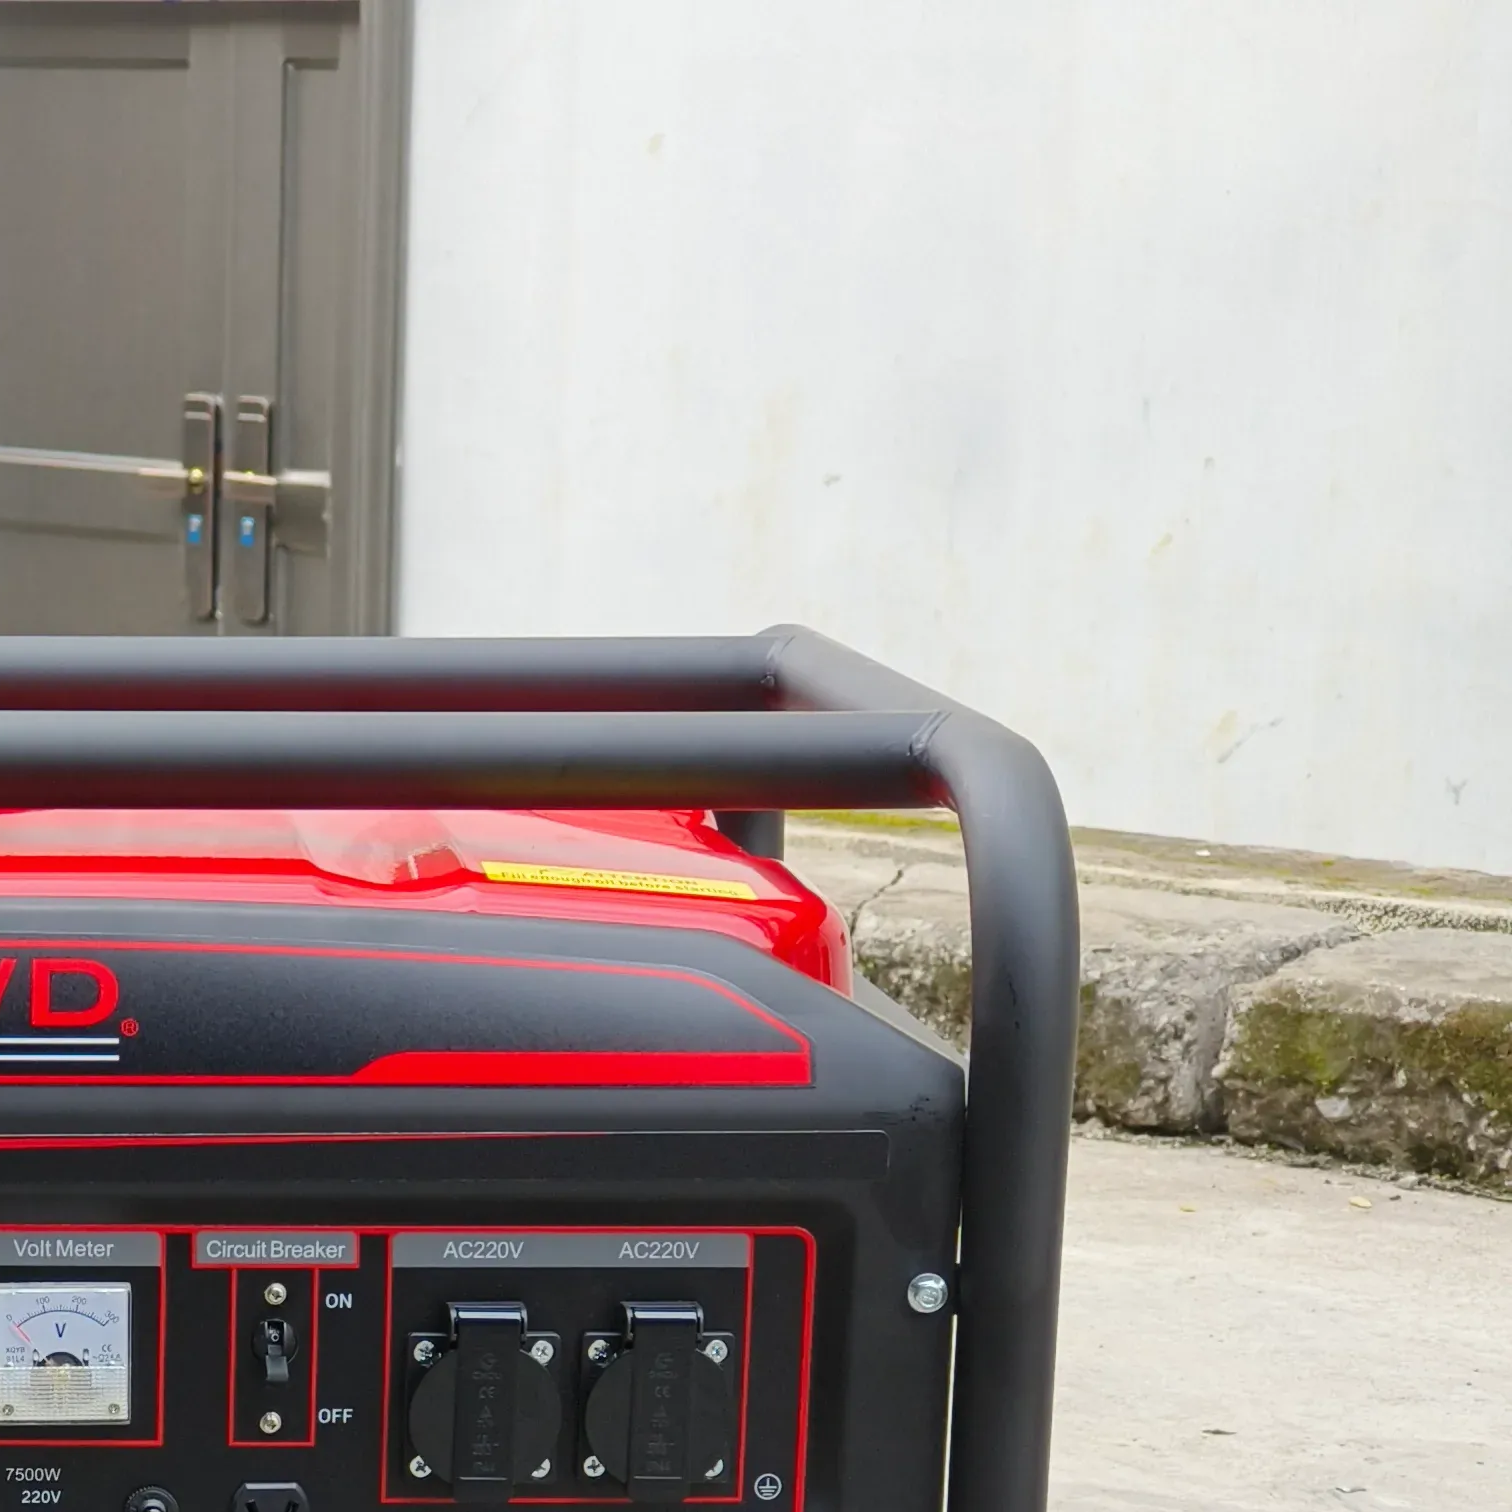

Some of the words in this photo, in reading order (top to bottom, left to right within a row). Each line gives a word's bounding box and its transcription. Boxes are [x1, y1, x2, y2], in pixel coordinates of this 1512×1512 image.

[13, 1239, 51, 1257] Volt
[55, 1240, 114, 1257] Meter
[206, 1240, 267, 1258] Circuit
[270, 1240, 346, 1258] Breaker
[443, 1241, 524, 1259] AC220V
[618, 1241, 700, 1259] AC220V
[35, 1296, 51, 1305] 100
[71, 1295, 87, 1306] 200
[325, 1293, 353, 1309] ON
[104, 1310, 120, 1324] 300
[55, 1323, 66, 1338] V
[317, 1408, 354, 1424] OFF
[5, 1468, 61, 1481] 7500W
[21, 1490, 61, 1504] 220V
